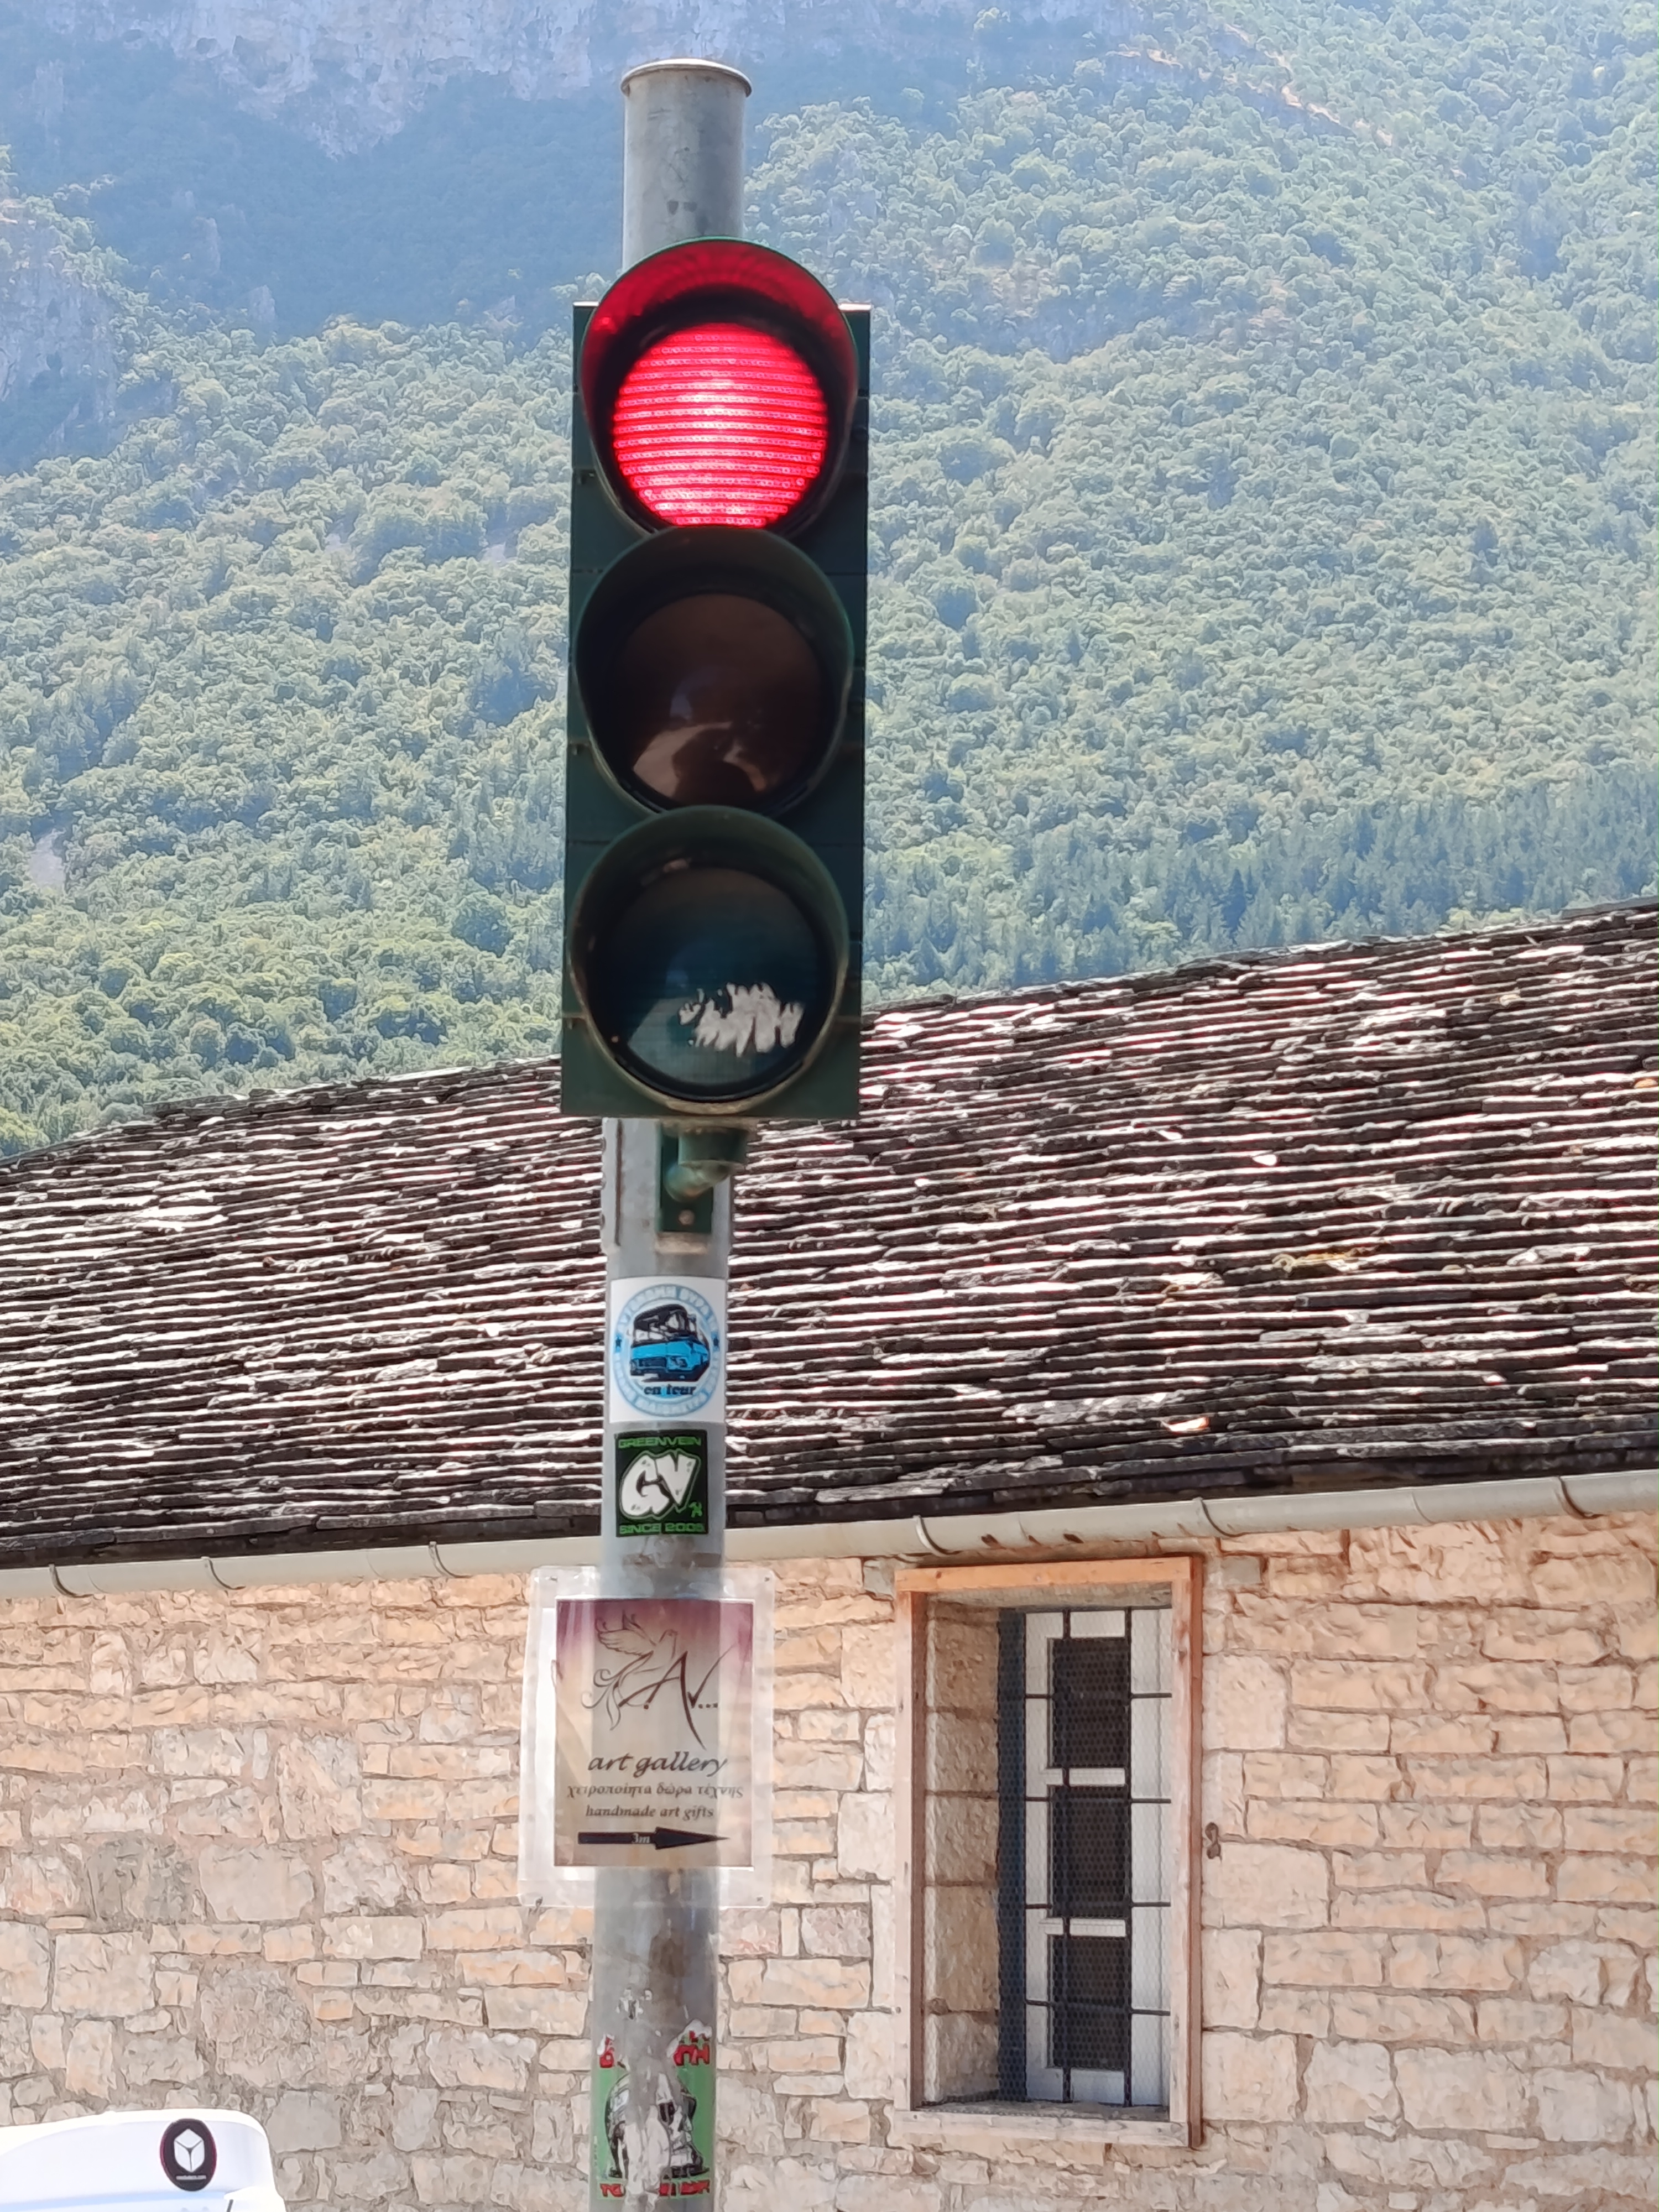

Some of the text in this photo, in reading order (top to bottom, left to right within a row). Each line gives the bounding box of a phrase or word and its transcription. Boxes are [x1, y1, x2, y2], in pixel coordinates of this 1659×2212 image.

[619, 1523, 661, 1535] SINCE
[588, 1751, 728, 1778] art gallery
[567, 1782, 744, 1799] χειροποίητα δώρα τέχνης
[586, 1804, 714, 1821] handmade art gifts
